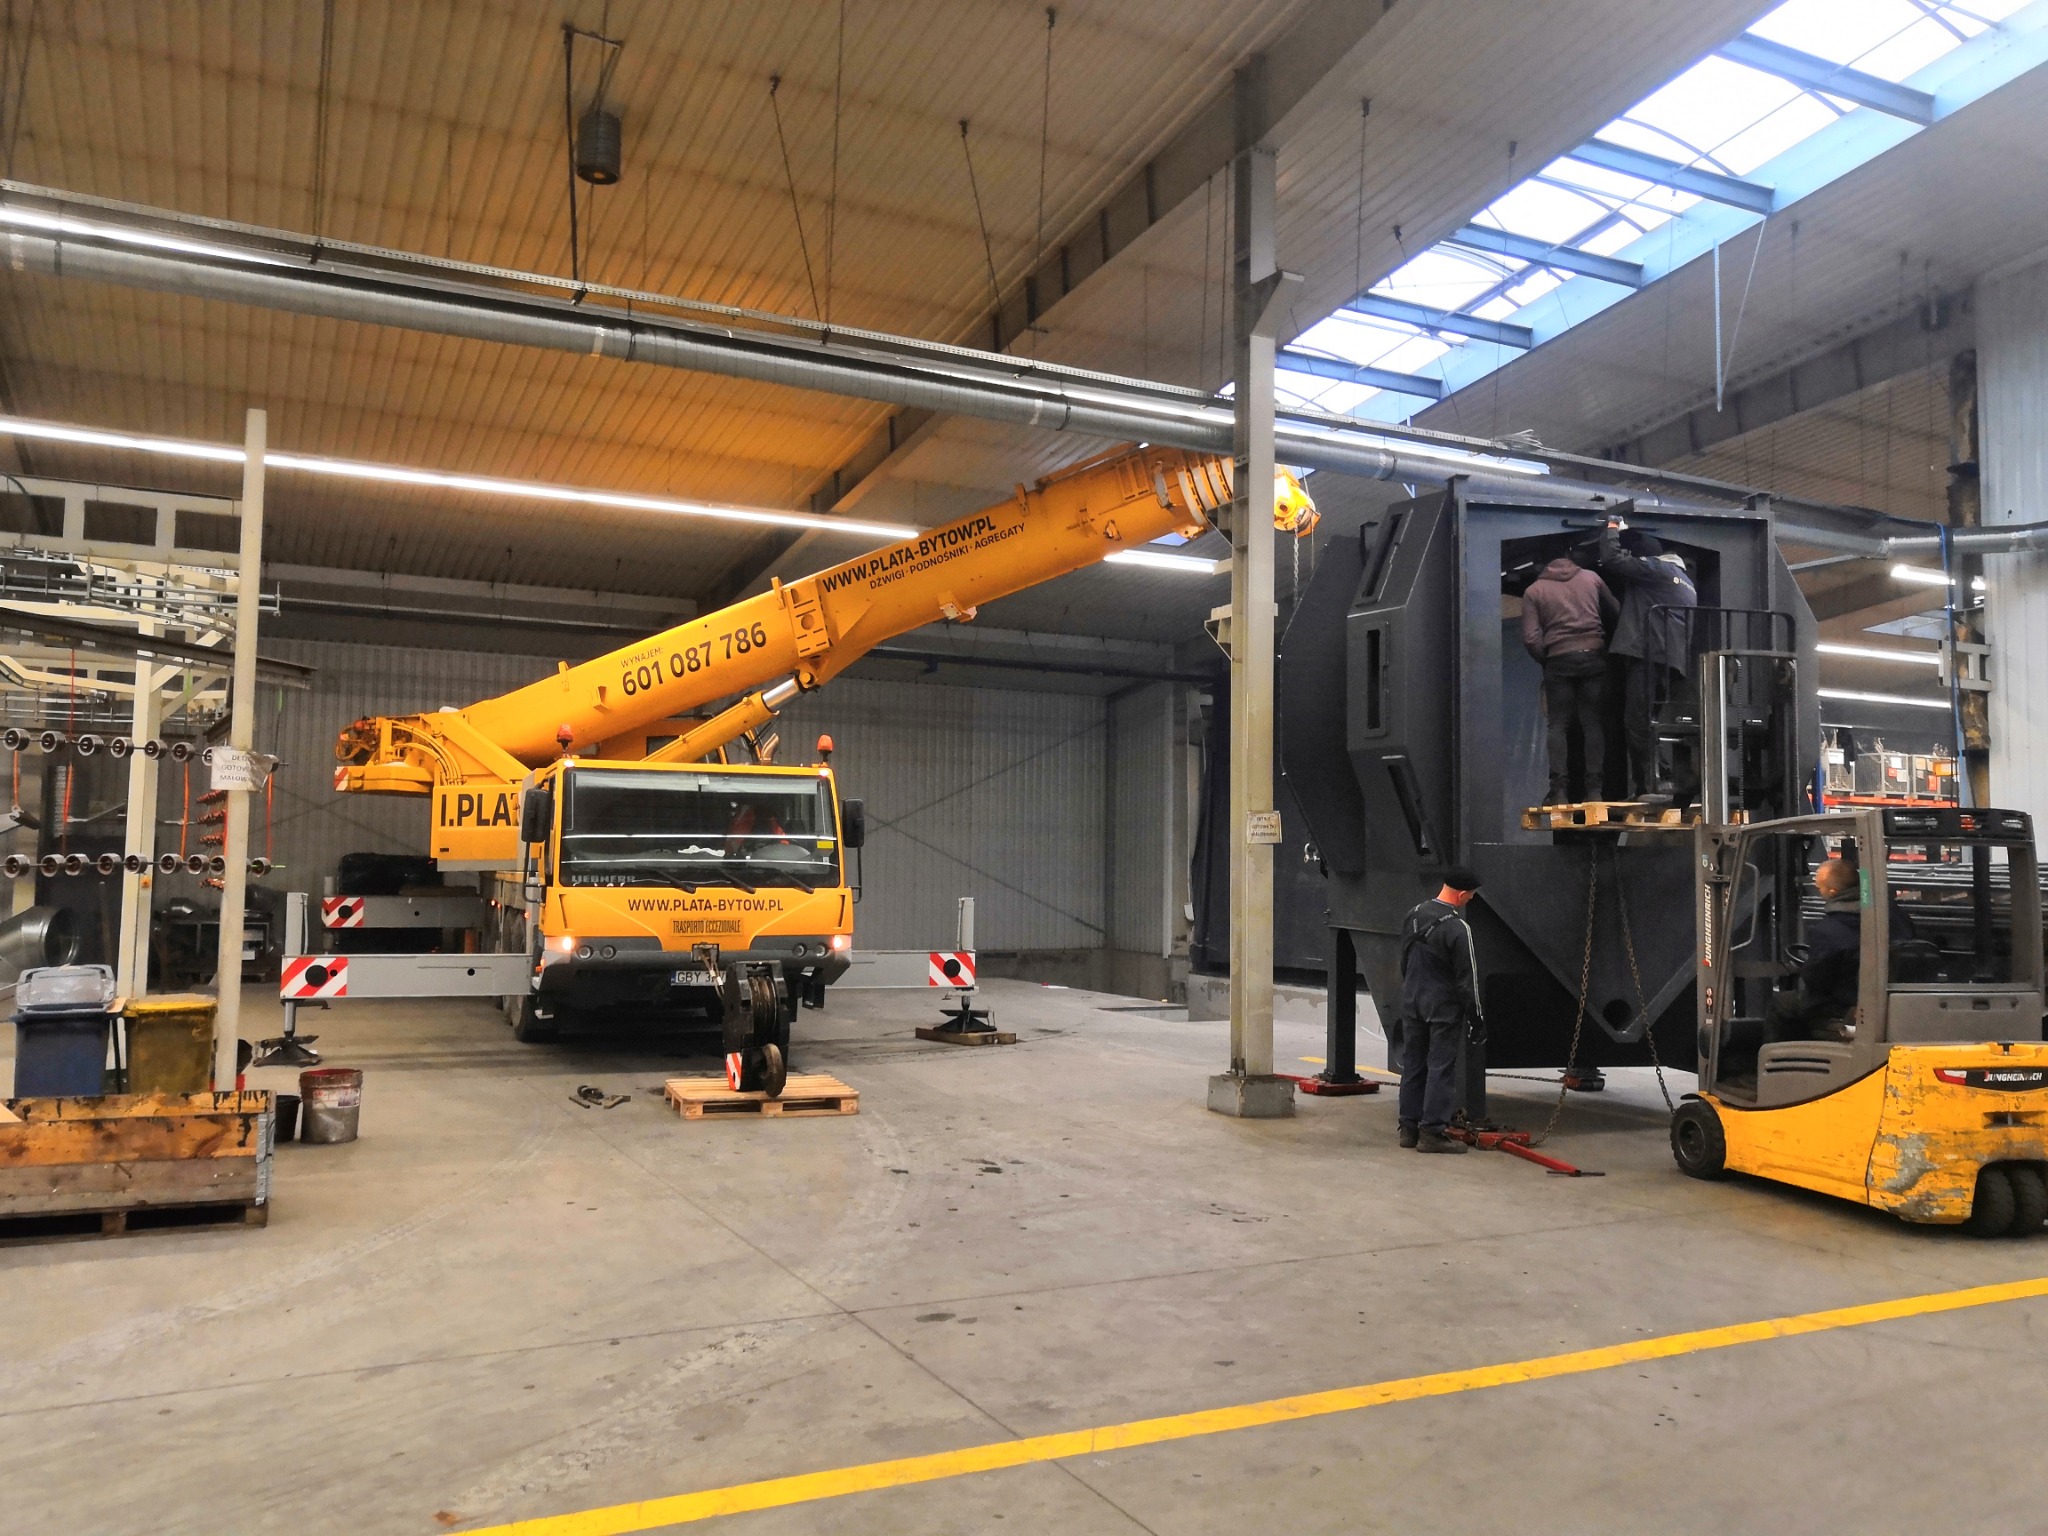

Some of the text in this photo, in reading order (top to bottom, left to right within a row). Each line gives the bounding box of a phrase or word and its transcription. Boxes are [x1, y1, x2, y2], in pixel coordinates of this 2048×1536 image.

[822, 515, 996, 593] WWW.PLATA-BYTOW.PL
[909, 544, 969, 575] PODNOŚNIKI
[974, 522, 1026, 550] AGREGATY
[622, 621, 767, 696] 601 087 786
[628, 899, 784, 912] WWW.PLATA-BYTOW.PL
[1703, 884, 1712, 967] JUNGHEINRICH
[677, 971, 700, 983] GBY
